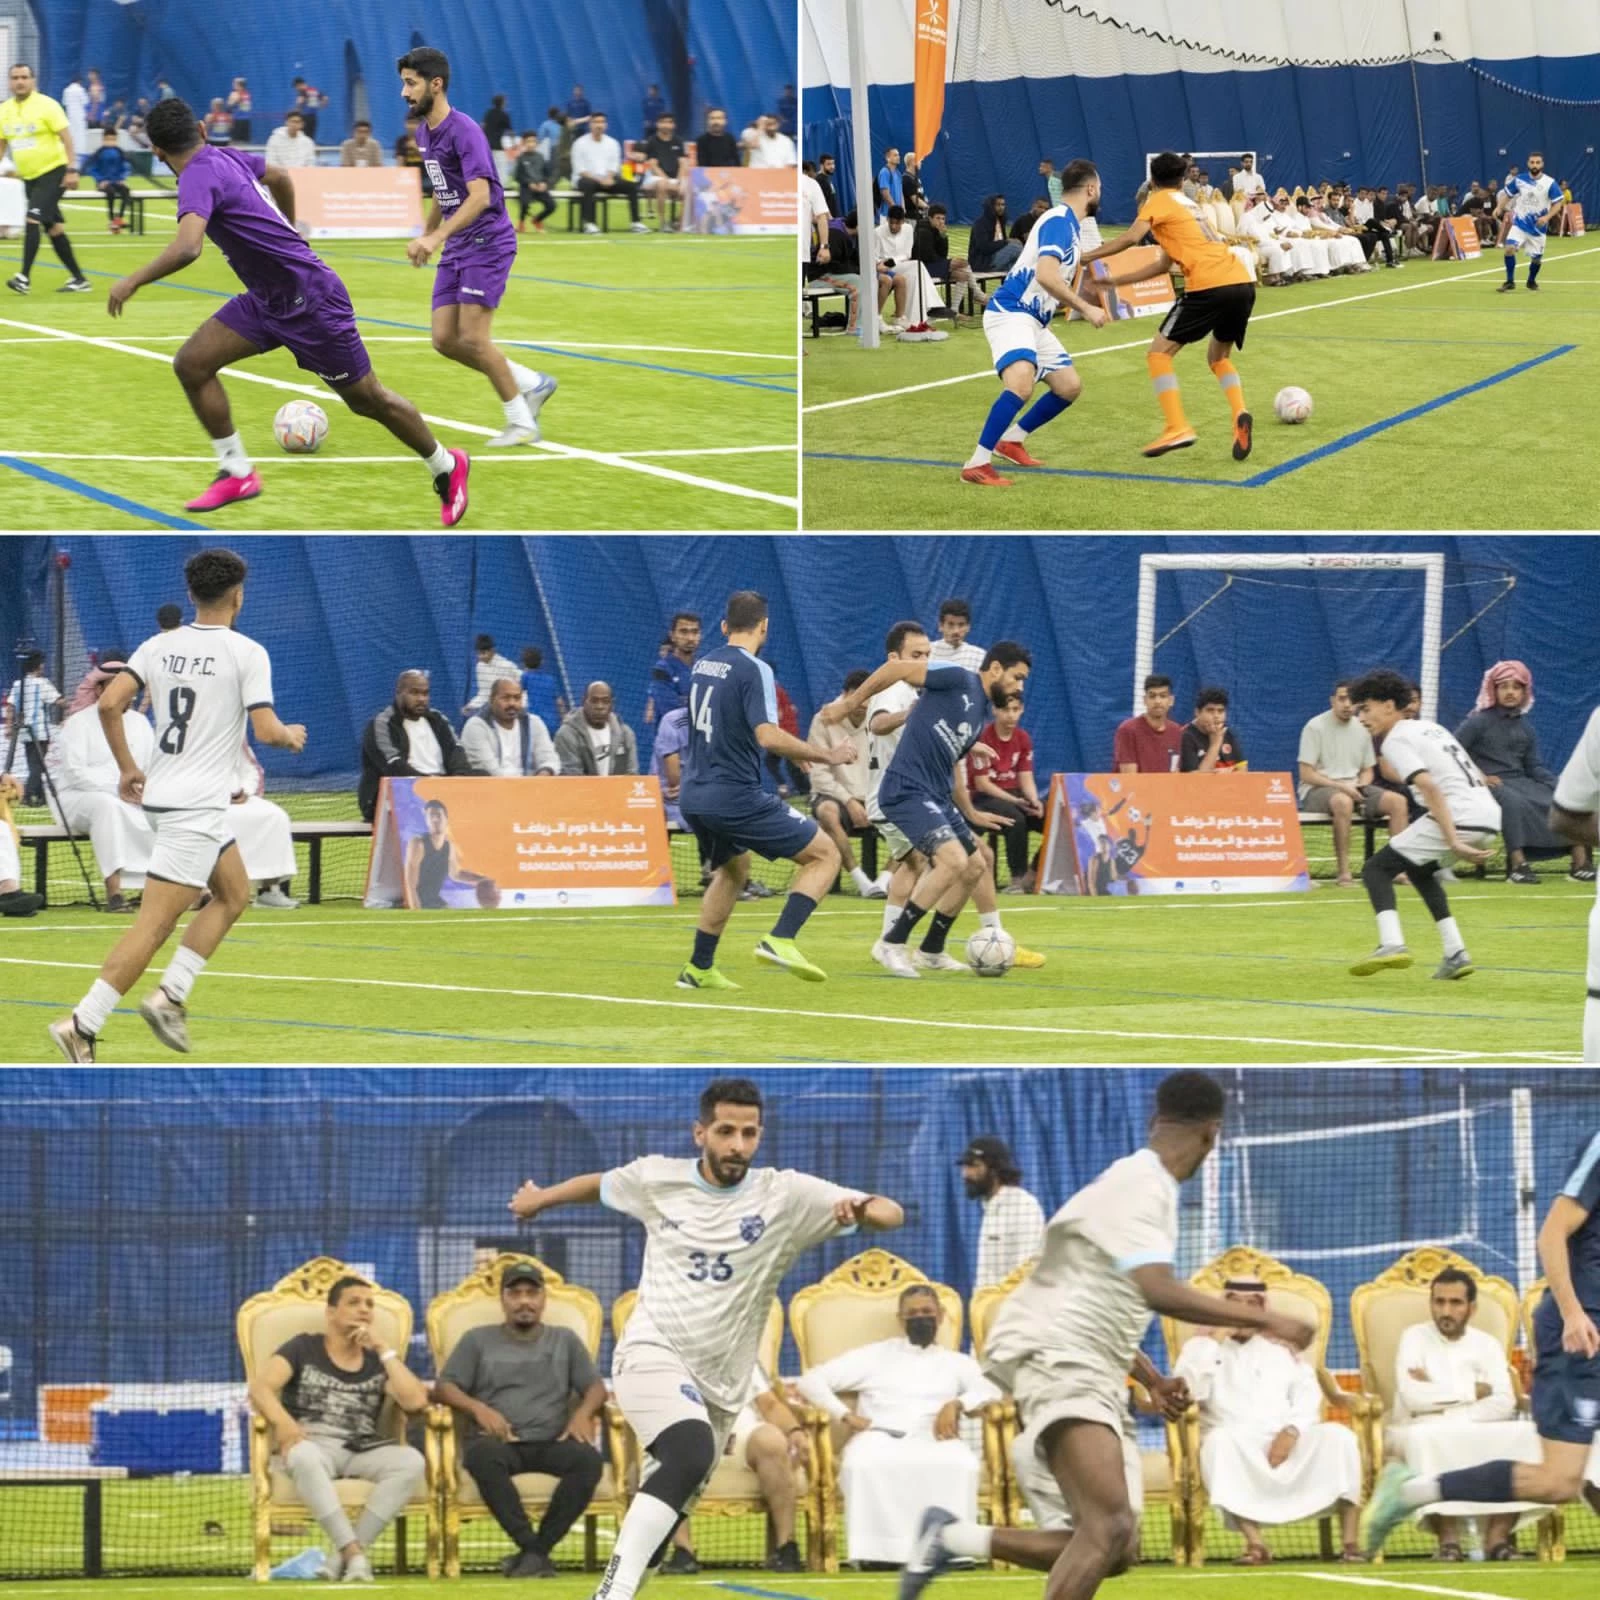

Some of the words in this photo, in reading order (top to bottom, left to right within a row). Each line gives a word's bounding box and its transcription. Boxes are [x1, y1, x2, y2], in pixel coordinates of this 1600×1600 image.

[159, 686, 197, 756] 8
[690, 683, 714, 743] 14
[519, 861, 575, 872] RAMADAN
[576, 860, 649, 871] TOURNAMENT
[1176, 851, 1225, 862] RAMADAN
[1226, 851, 1288, 861] TOURNAMENT
[687, 1252, 733, 1281] 36
